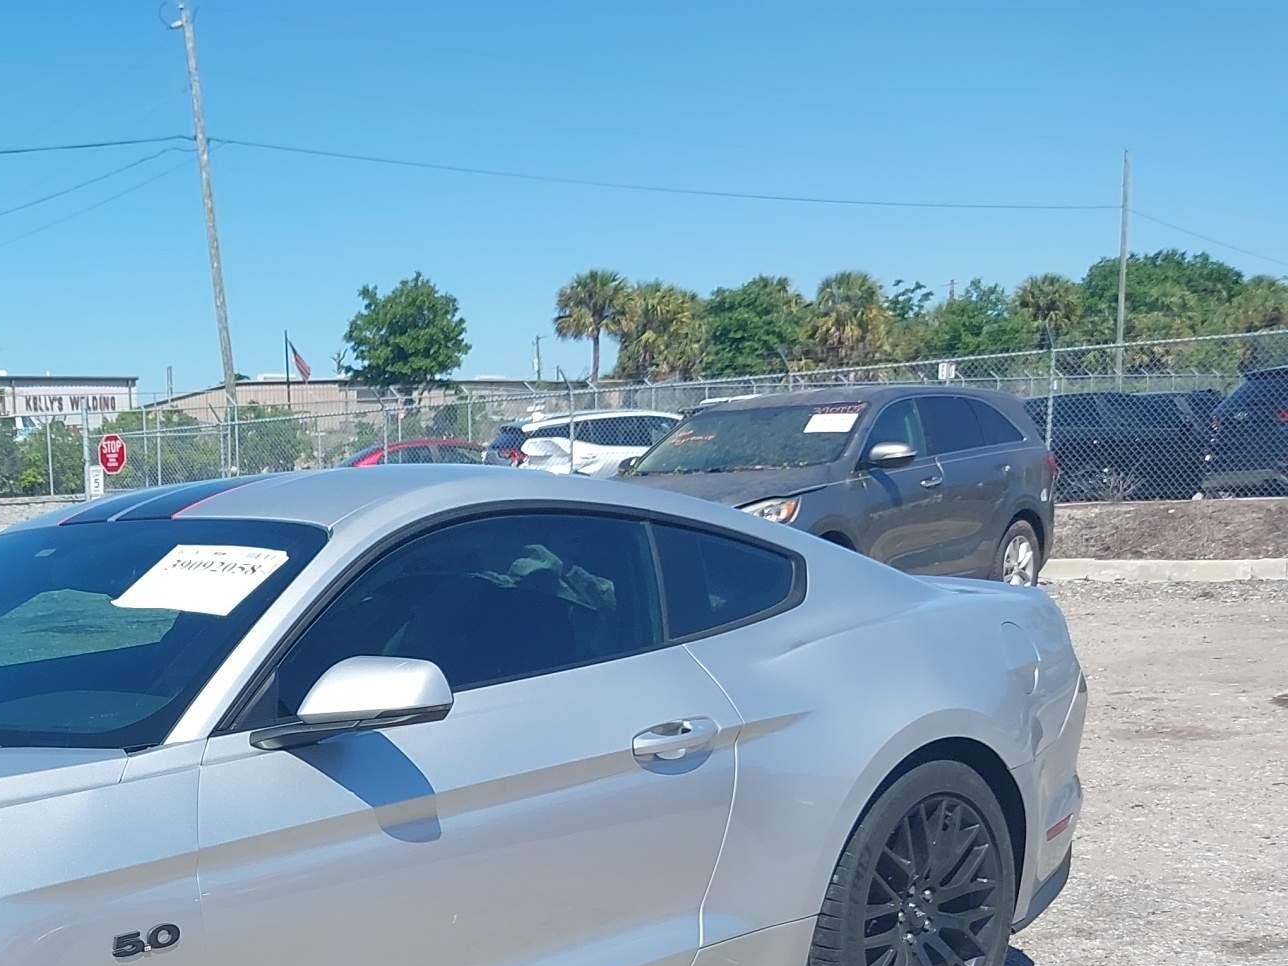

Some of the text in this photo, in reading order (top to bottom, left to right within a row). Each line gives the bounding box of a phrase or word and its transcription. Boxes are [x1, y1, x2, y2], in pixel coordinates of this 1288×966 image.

[24, 394, 63, 412] KELLY'S
[103, 440, 122, 454] STOP
[172, 559, 263, 575] 39092058
[112, 923, 181, 958] 5.0
